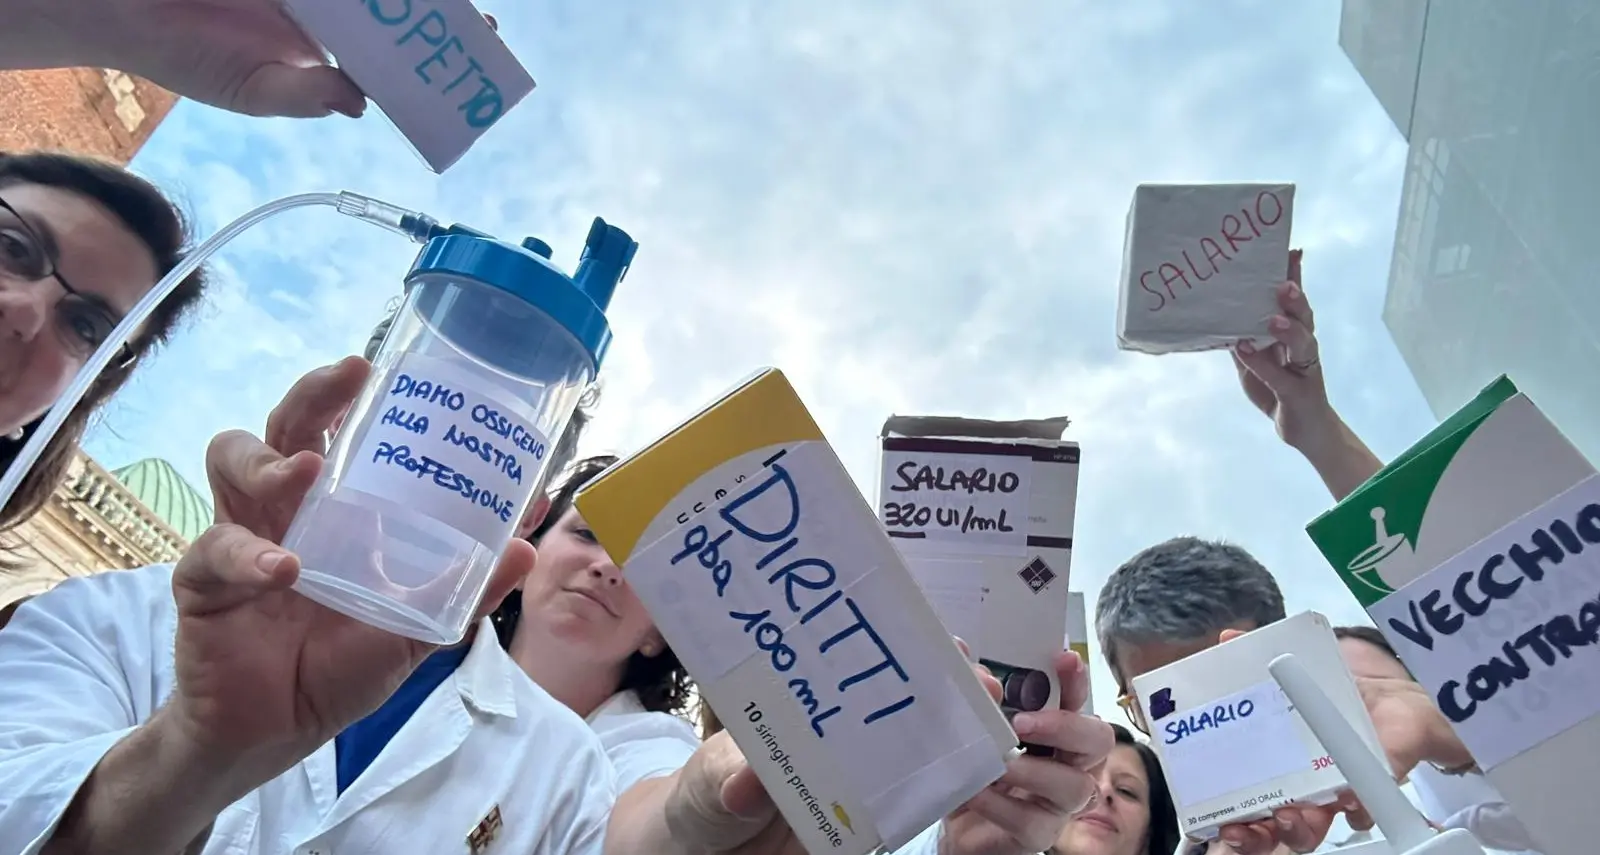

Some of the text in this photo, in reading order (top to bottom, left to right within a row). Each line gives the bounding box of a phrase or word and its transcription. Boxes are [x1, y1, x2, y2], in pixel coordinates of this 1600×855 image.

[1140, 191, 1282, 312] SALARIO
[381, 405, 523, 485] ALLA NOSTRA
[391, 374, 545, 461] DIAMO OSSIGENO
[373, 442, 516, 522] PROFESSIONE
[884, 502, 931, 528] 320
[891, 461, 1020, 494] SALARIO
[720, 463, 915, 724] DIRITTI
[1389, 503, 1600, 650] VECCHIO
[730, 609, 796, 671] 100
[788, 678, 843, 738] mL
[1164, 699, 1254, 745] SALARIO
[743, 701, 843, 848] 10 siringhe preriempite
[1198, 805, 1236, 820] compresse
[1240, 797, 1257, 809] USO
[1258, 788, 1284, 804] ORALE
